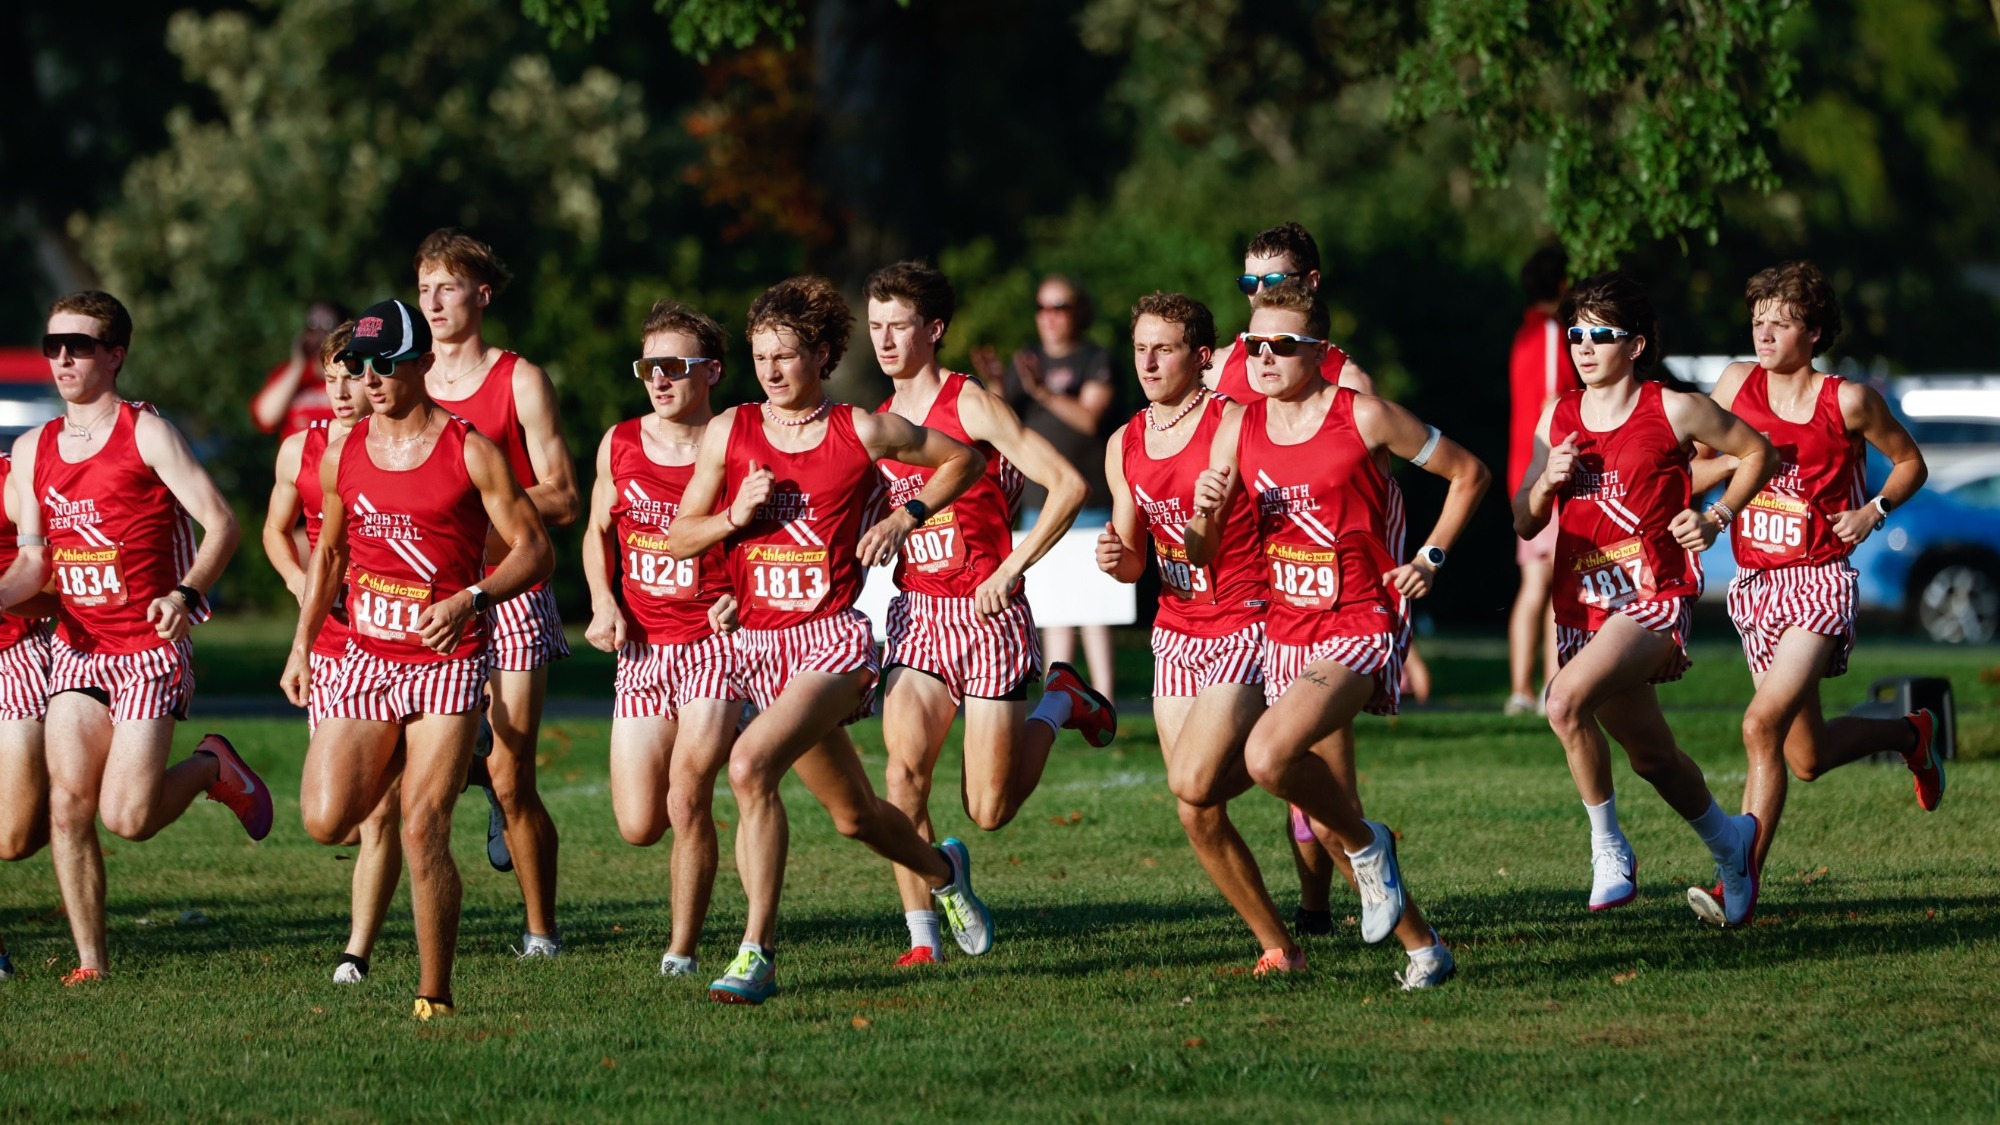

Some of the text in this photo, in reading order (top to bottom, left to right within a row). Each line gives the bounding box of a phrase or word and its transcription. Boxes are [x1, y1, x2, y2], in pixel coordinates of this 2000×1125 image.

[890, 473, 925, 495] NORTH
[1575, 470, 1619, 486] NORTH
[769, 493, 811, 506] ORTH
[889, 487, 921, 508] CENTR
[1264, 484, 1310, 503] NORTH
[1572, 483, 1628, 501] ENTRAL
[54, 498, 95, 517] NORTH
[632, 499, 680, 516] NORTH
[755, 507, 818, 521] ENTRAL
[1142, 497, 1181, 514] NORTH
[1261, 498, 1321, 516] CENTRAL
[50, 511, 103, 530] CENTRAL
[363, 513, 412, 527] NORTH
[1741, 509, 1802, 547] 1805
[358, 525, 422, 541] CENTRAL
[627, 532, 671, 551] Athleti
[53, 547, 97, 562] Athletic
[747, 547, 824, 563] Athletic NET
[904, 527, 955, 564] 1807
[1267, 543, 1313, 562] Athletic
[1315, 553, 1333, 561] NET
[629, 551, 694, 588] 1826
[1574, 549, 1621, 571] Athletic
[58, 565, 121, 596] 1834
[754, 565, 824, 599] 1813
[1156, 554, 1207, 592] 1803
[1272, 561, 1335, 598] 1829
[1582, 558, 1643, 604] 1817
[357, 572, 409, 596] Athletic
[357, 591, 420, 633] 1811
